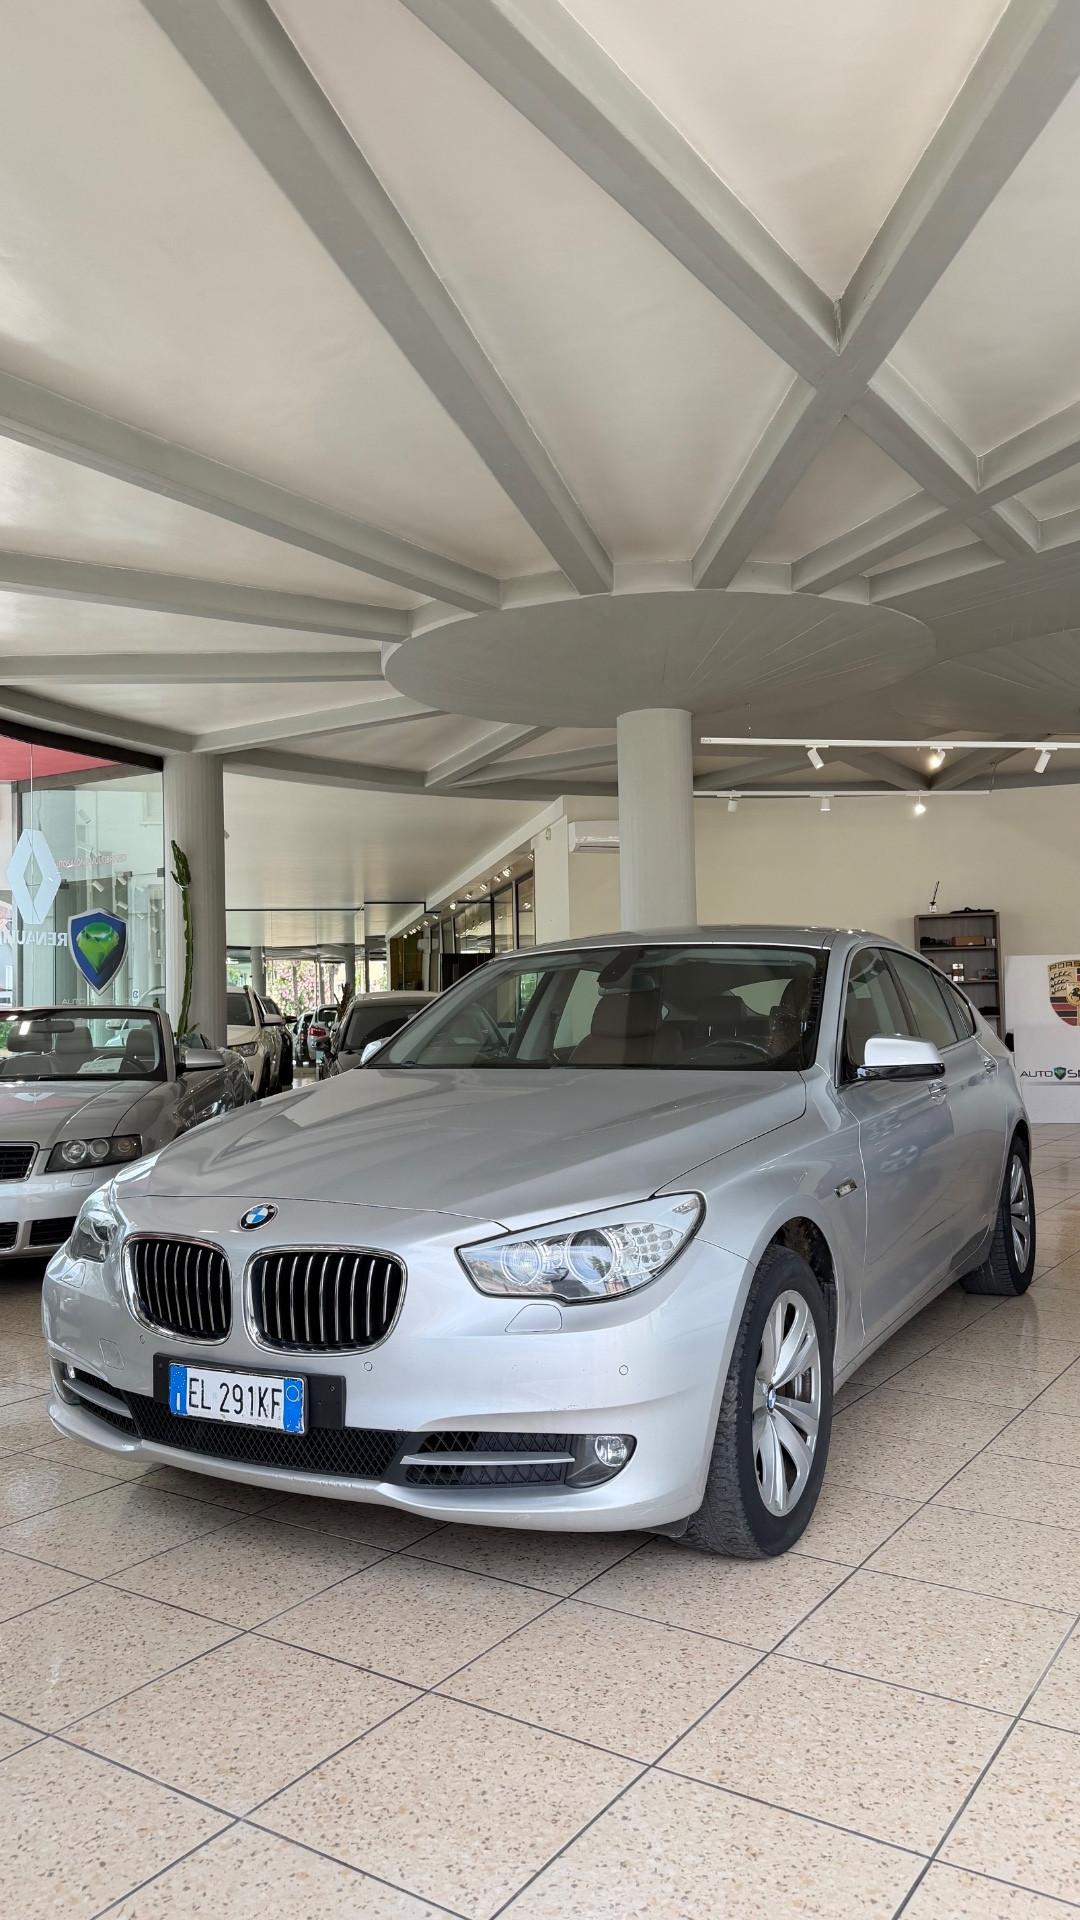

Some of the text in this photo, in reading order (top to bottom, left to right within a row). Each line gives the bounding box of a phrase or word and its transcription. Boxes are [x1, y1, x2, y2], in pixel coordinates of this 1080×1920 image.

[1020, 1070, 1053, 1078] AUTO
[188, 1377, 283, 1419] EL 291KF
